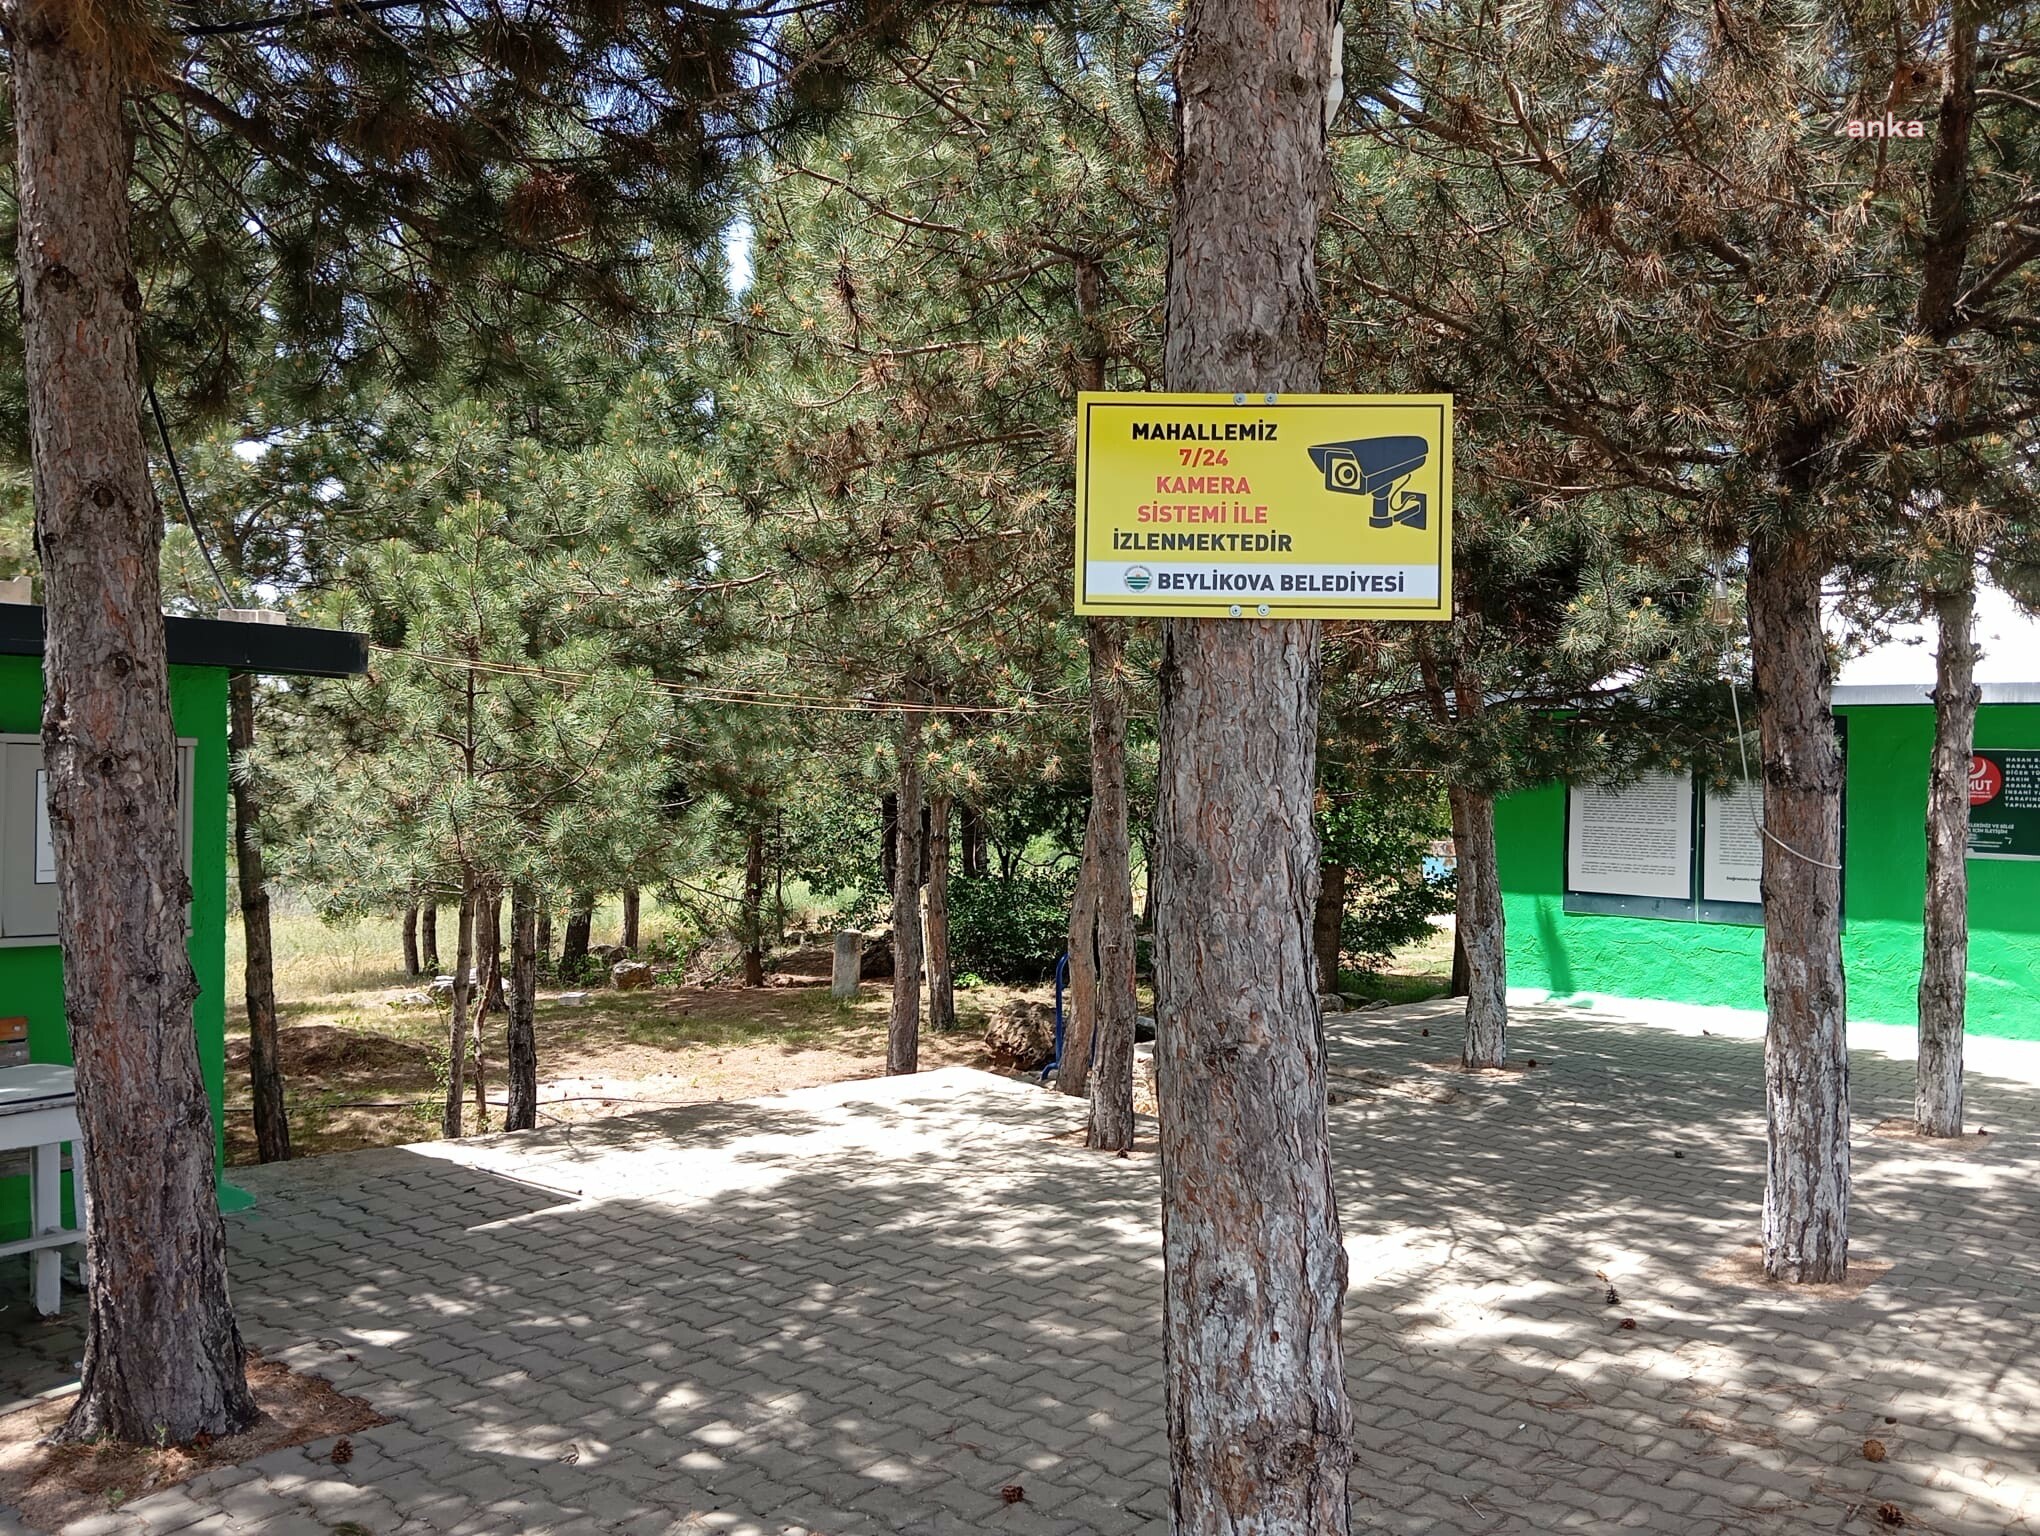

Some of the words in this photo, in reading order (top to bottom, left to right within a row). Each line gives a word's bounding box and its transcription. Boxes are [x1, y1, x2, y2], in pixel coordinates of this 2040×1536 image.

[1132, 419, 1278, 441] MAHALLEMİZ
[1179, 447, 1229, 467] 7/24
[1156, 476, 1251, 494] KAMERA
[1137, 500, 1227, 523] SİSTEMİ
[1233, 501, 1268, 524] İLE
[1113, 528, 1292, 552] İZLENMEKTEDİR
[1158, 569, 1275, 591] BEYLİKOVA
[1281, 570, 1405, 592] BELEDİYESİ
